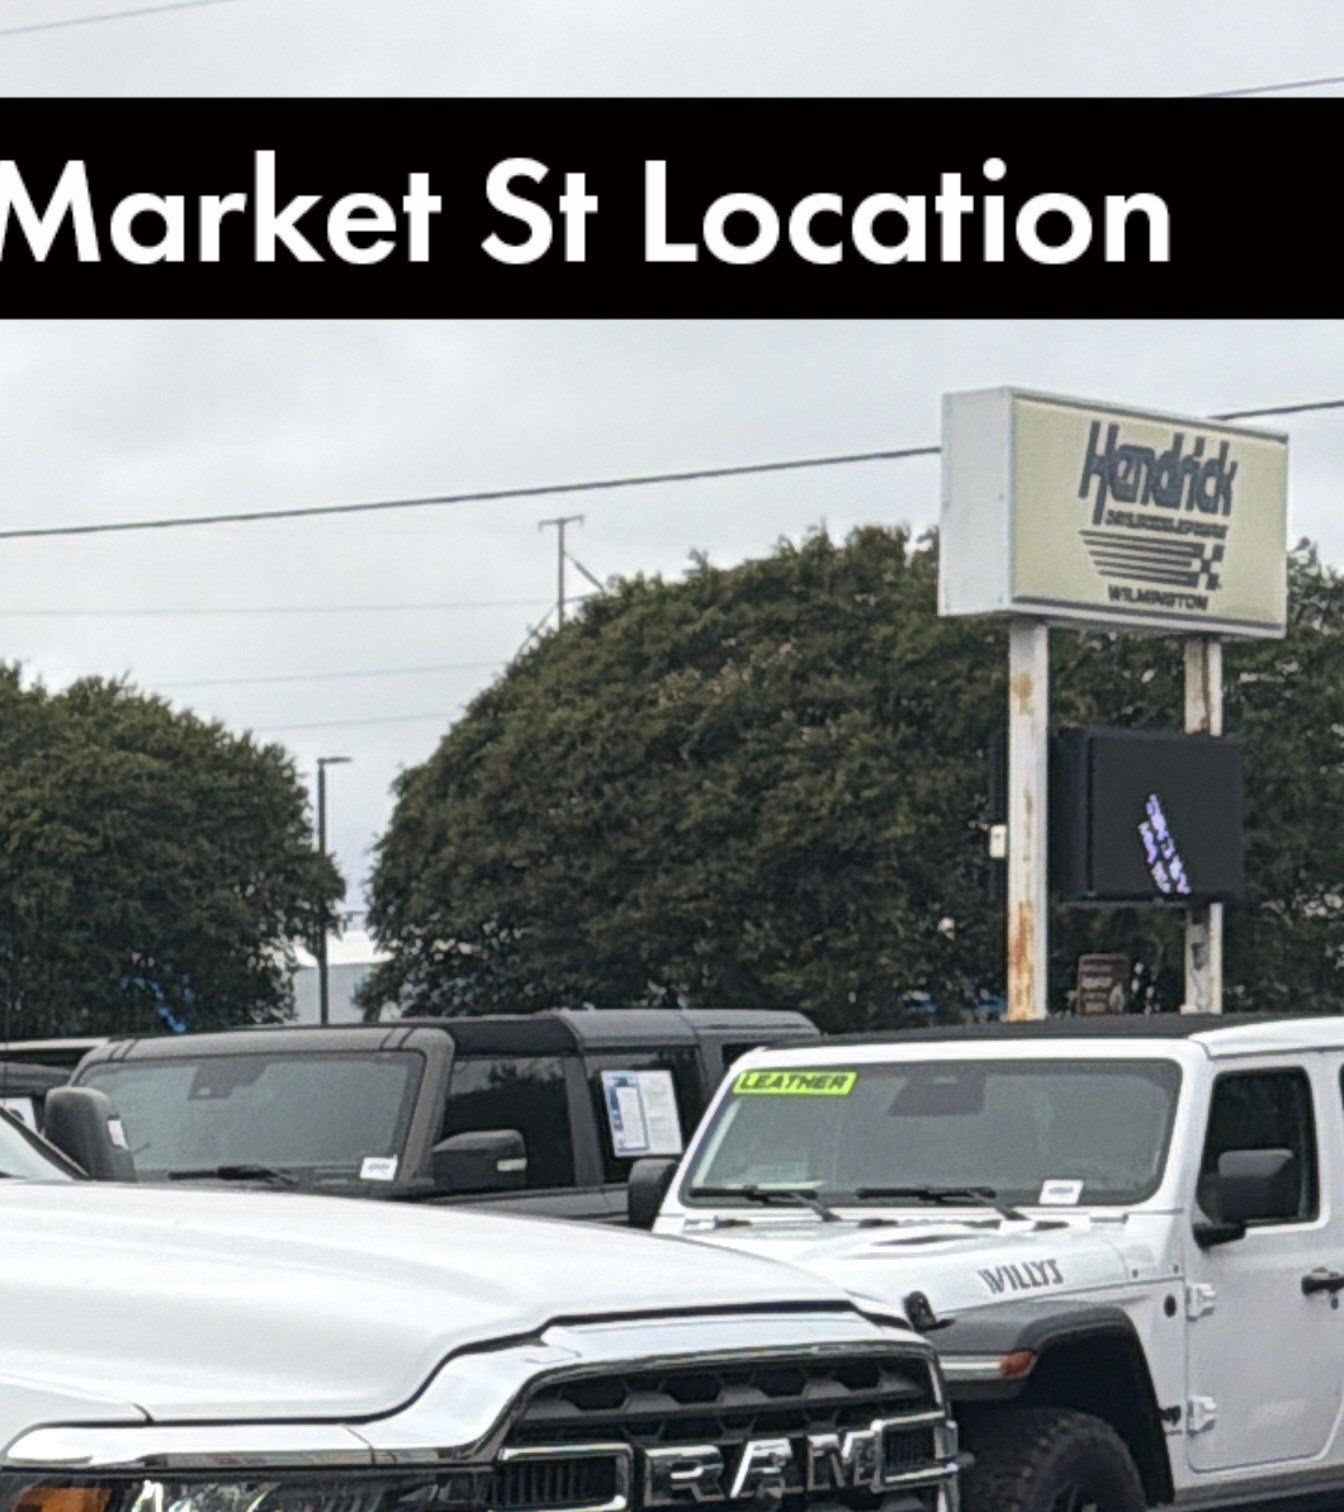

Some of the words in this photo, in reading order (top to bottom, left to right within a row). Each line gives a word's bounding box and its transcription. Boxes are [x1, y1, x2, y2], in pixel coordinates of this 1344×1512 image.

[1078, 420, 1238, 526] Hendrick
[1107, 584, 1209, 611] WILMINGTON
[740, 1074, 848, 1090] LEATHER
[976, 1259, 1064, 1294] WILLYS
[644, 1431, 876, 1506] RAM
